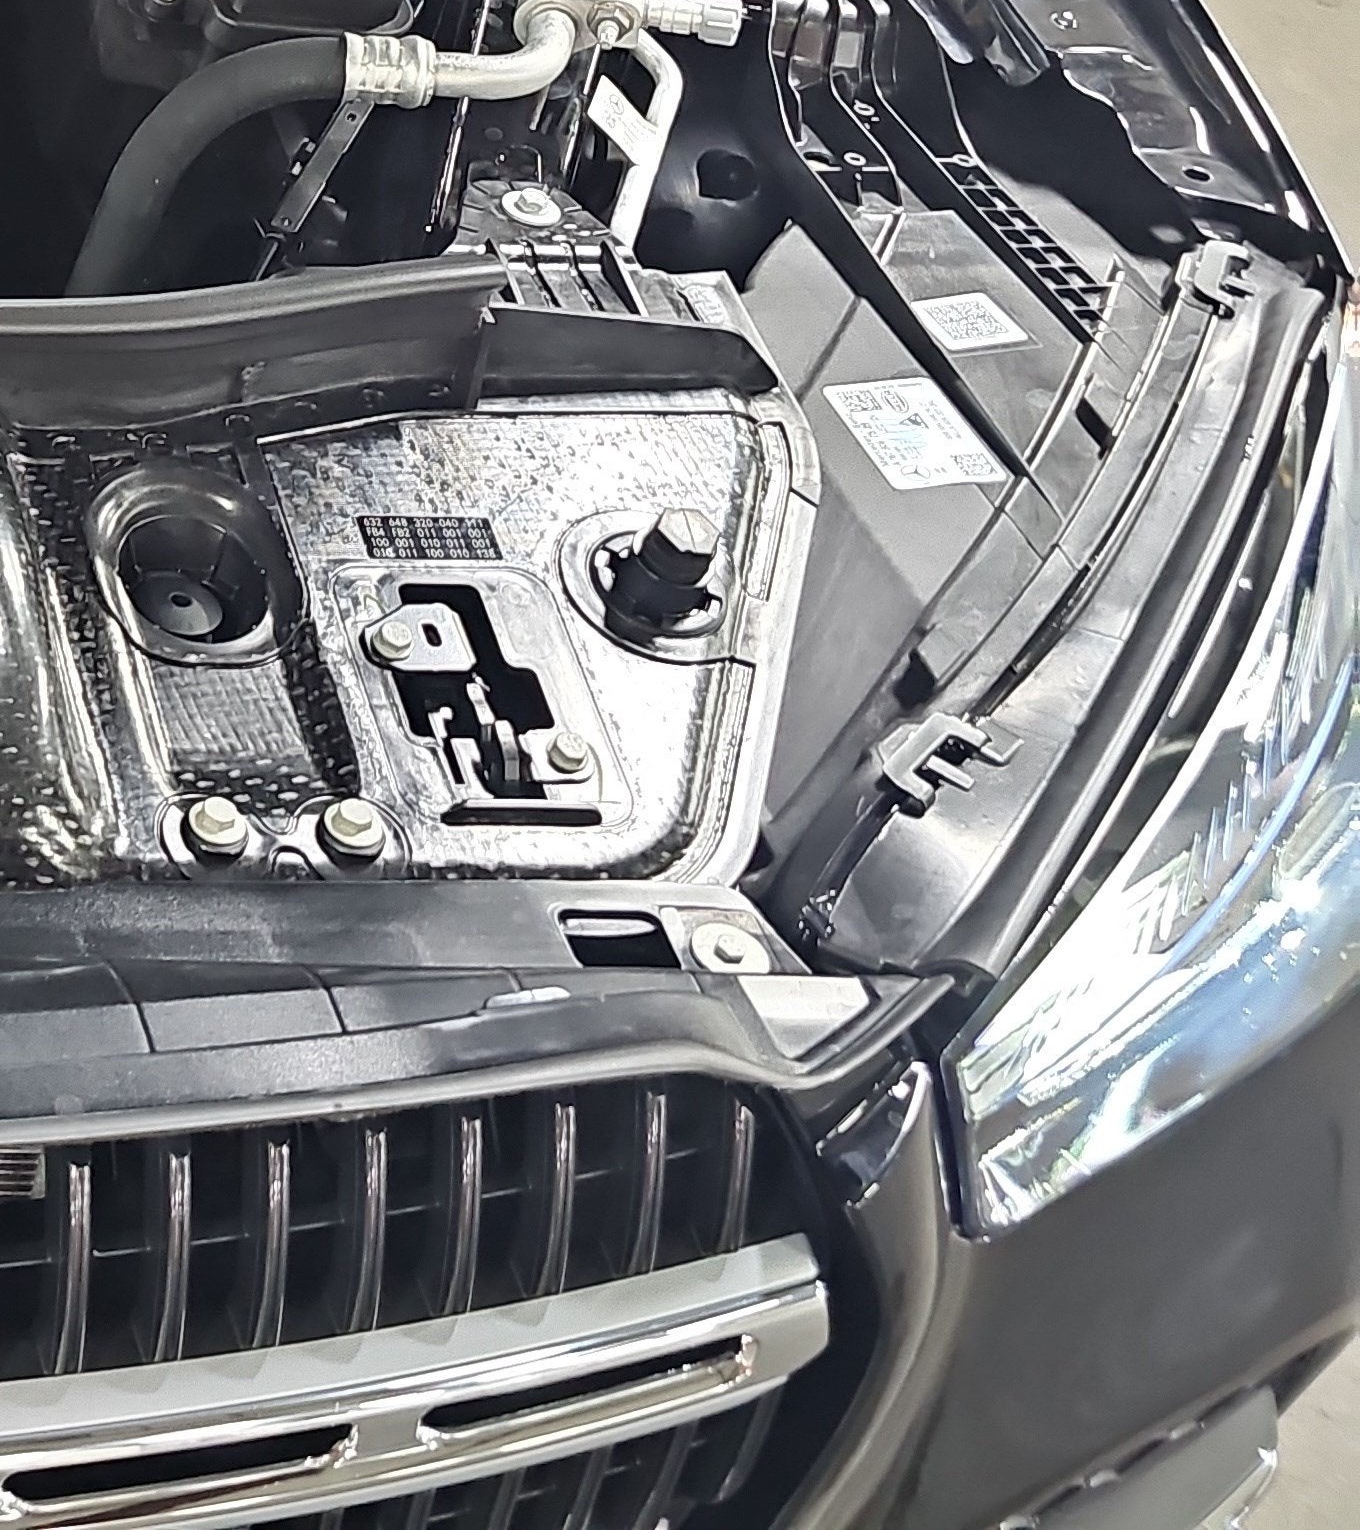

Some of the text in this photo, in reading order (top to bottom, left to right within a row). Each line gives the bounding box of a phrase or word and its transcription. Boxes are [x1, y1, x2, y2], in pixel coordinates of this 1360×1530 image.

[363, 517, 383, 527] 632
[438, 518, 459, 528] 040
[416, 527, 436, 538] 011
[442, 527, 462, 538] 001
[467, 527, 487, 538] 001
[370, 537, 490, 549] 100 001 010 011 001
[398, 548, 418, 558] 011
[425, 548, 444, 558] 100
[449, 548, 470, 559] 010
